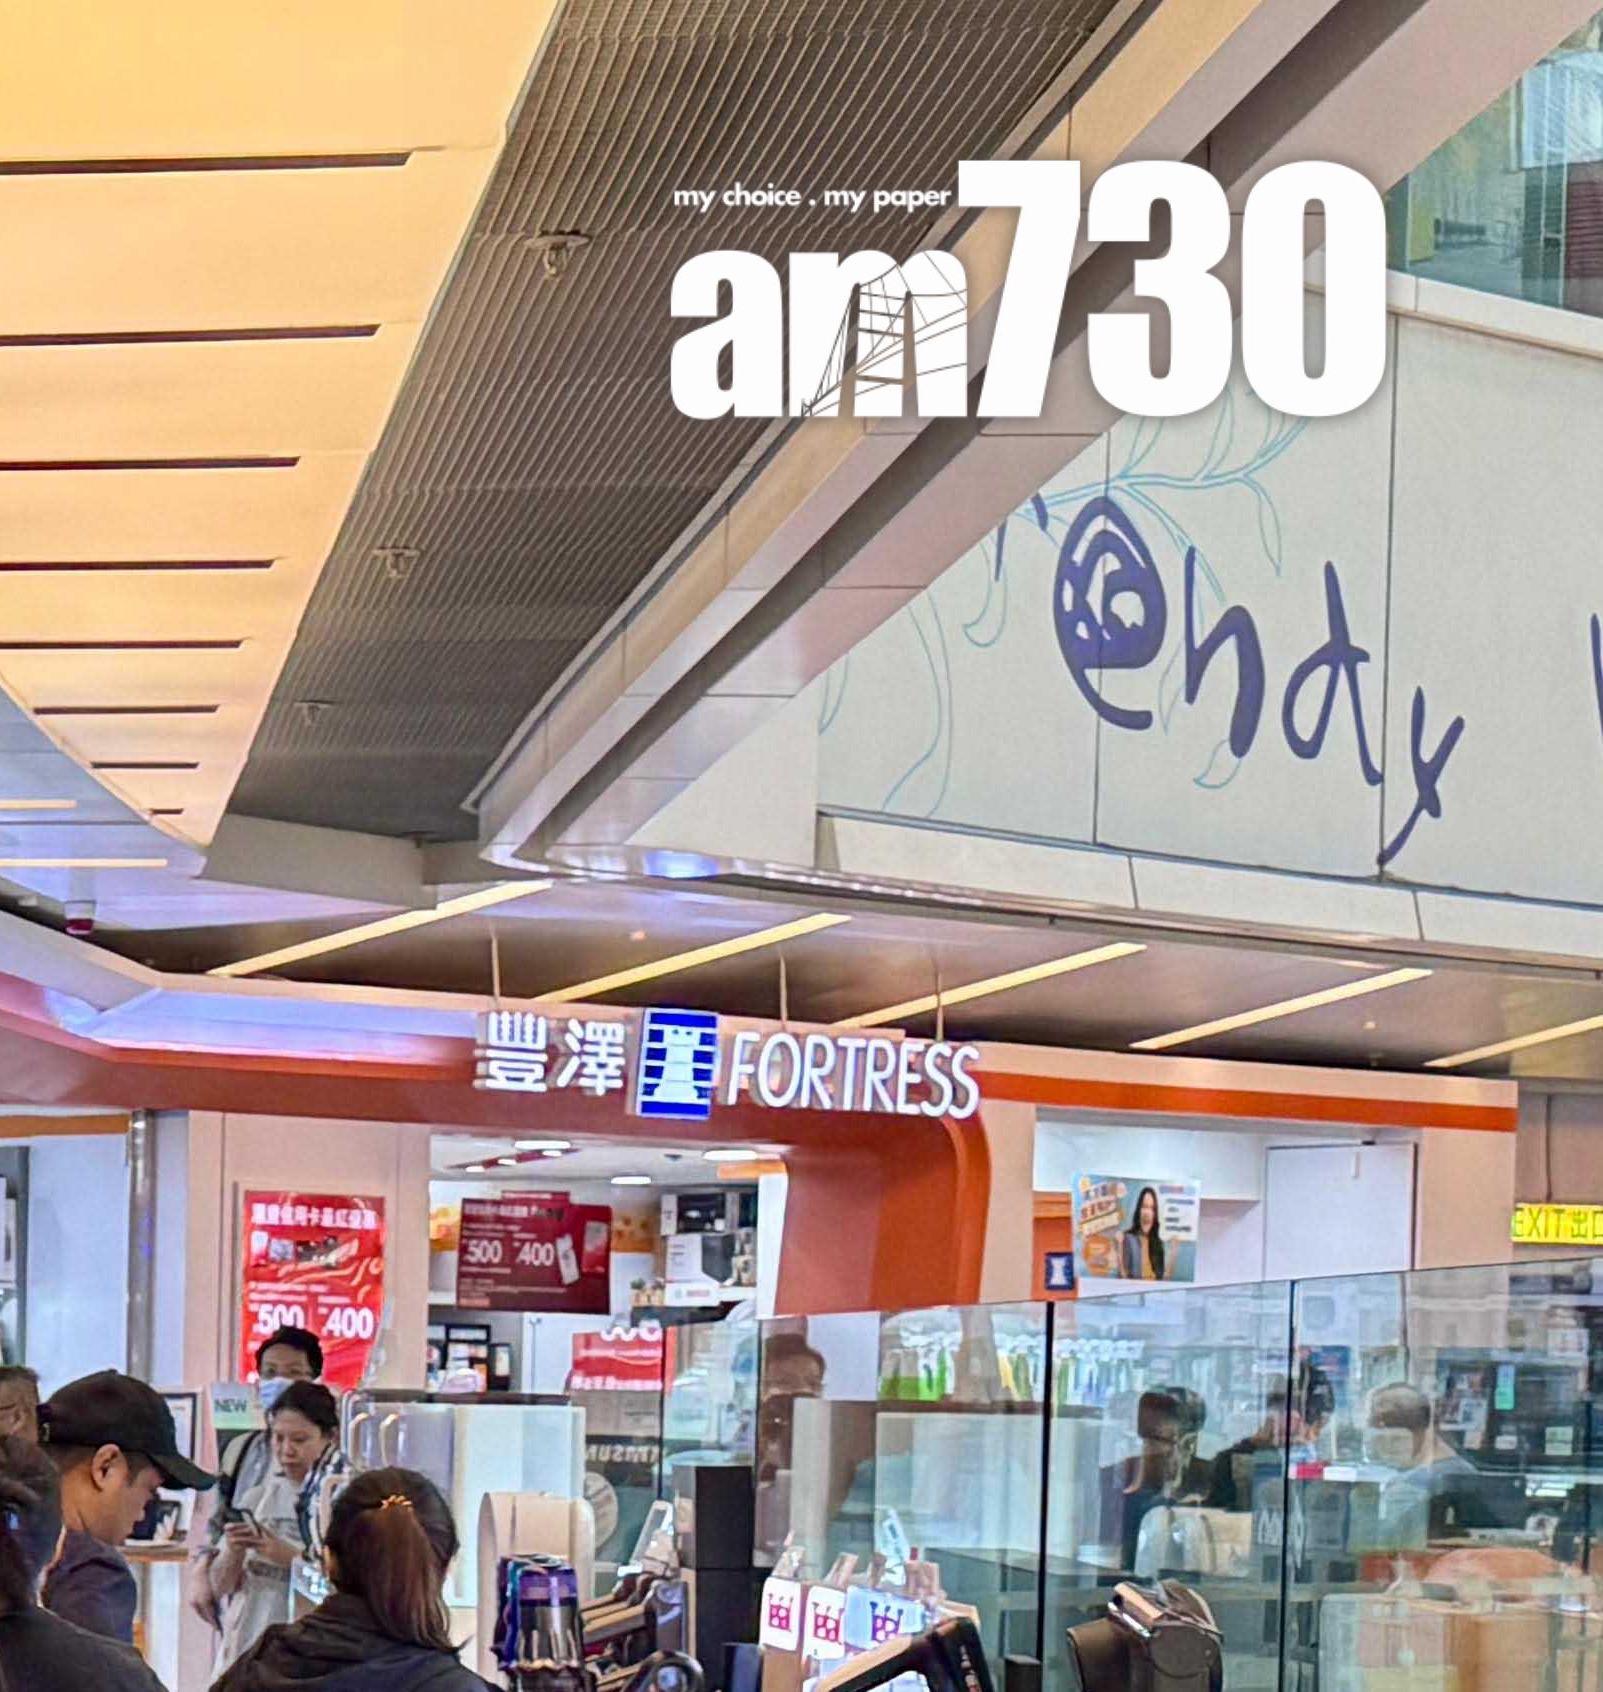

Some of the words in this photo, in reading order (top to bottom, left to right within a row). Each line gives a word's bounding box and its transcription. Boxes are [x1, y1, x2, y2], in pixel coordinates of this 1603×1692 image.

[483, 1010, 625, 1096] 豐澤
[728, 1031, 981, 1120] FORTRESS
[1513, 1207, 1566, 1239] EXIT
